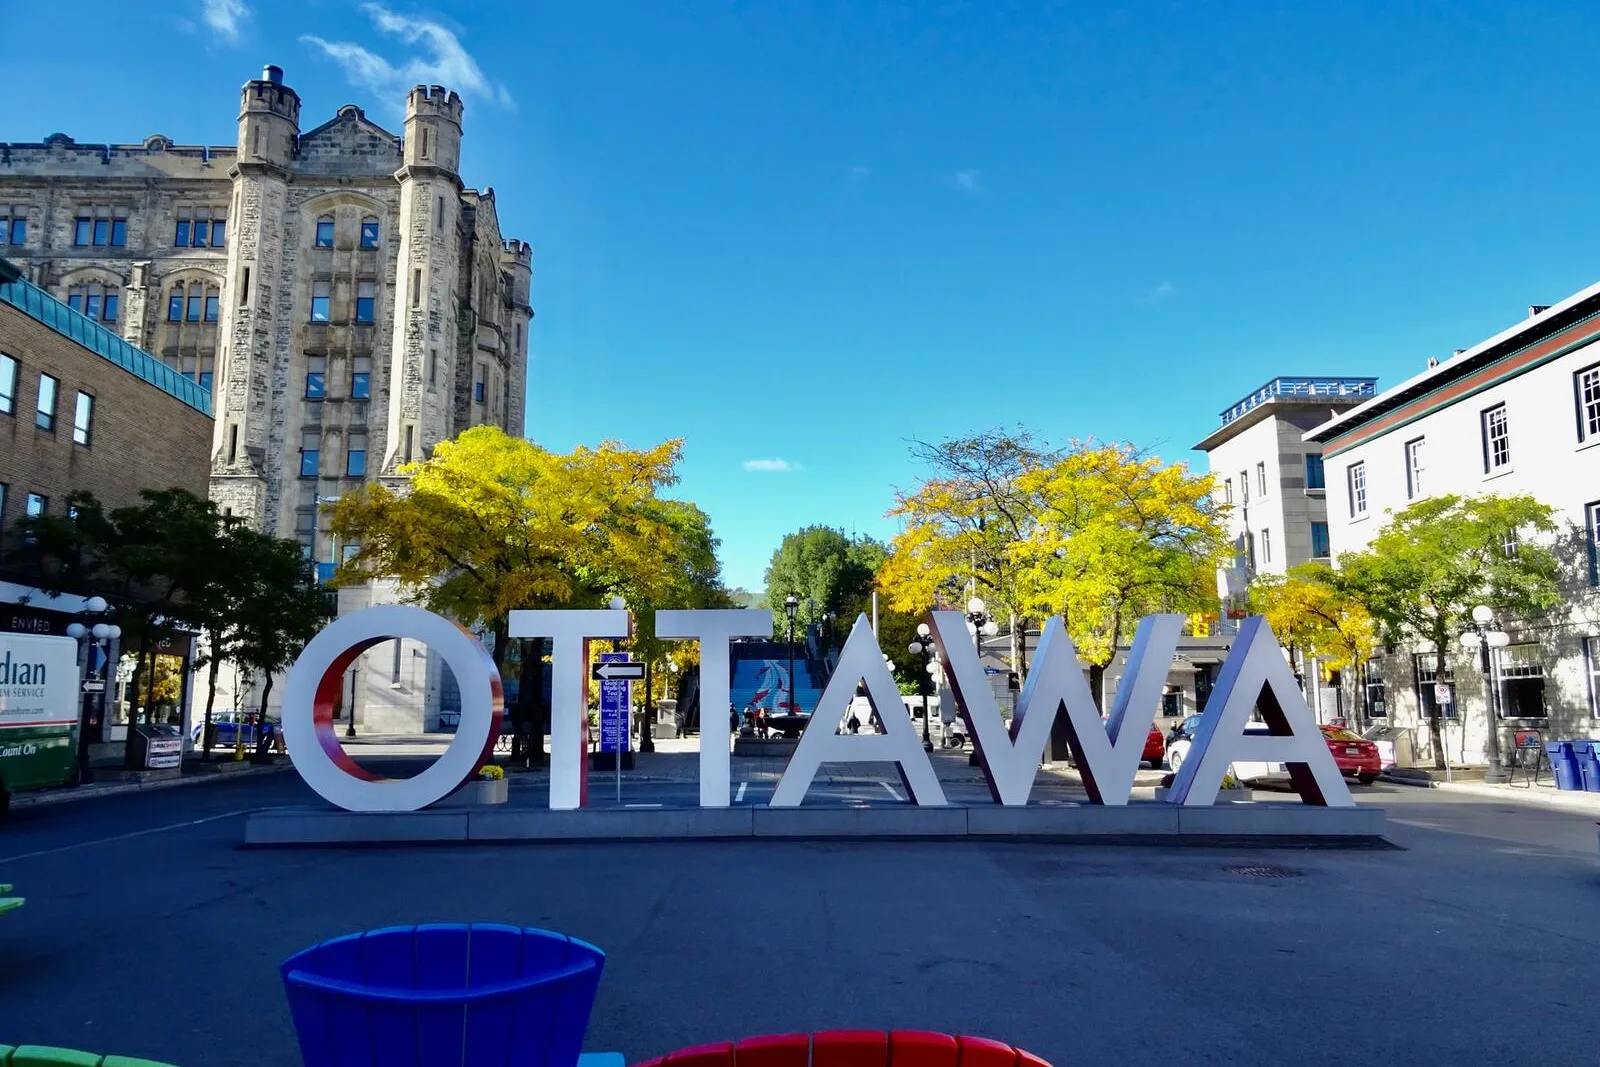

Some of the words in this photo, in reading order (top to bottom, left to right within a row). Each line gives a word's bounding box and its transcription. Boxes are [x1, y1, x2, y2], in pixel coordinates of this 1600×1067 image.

[13, 687, 45, 698] SERVICE
[282, 605, 1357, 812] OTTAWA
[23, 743, 37, 755] On
